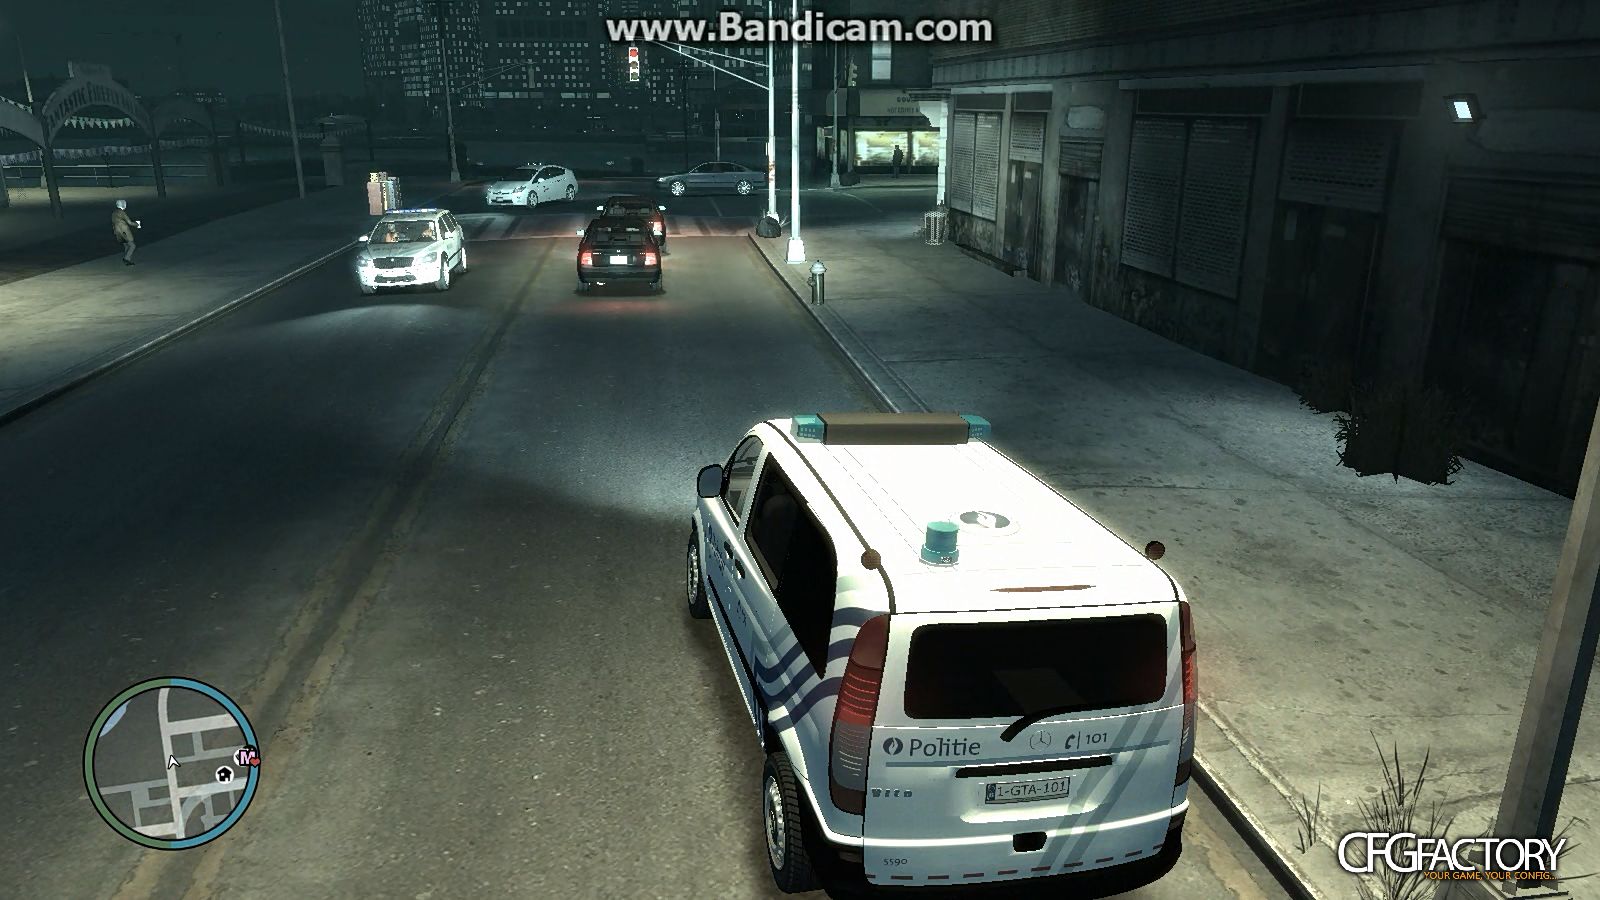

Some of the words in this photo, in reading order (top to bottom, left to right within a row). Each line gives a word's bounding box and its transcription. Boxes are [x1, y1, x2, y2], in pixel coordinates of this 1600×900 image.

[1085, 732, 1107, 745] 101
[909, 737, 981, 757] Politie
[997, 780, 1066, 797] 1-GTA-101
[883, 858, 908, 867] 5590
